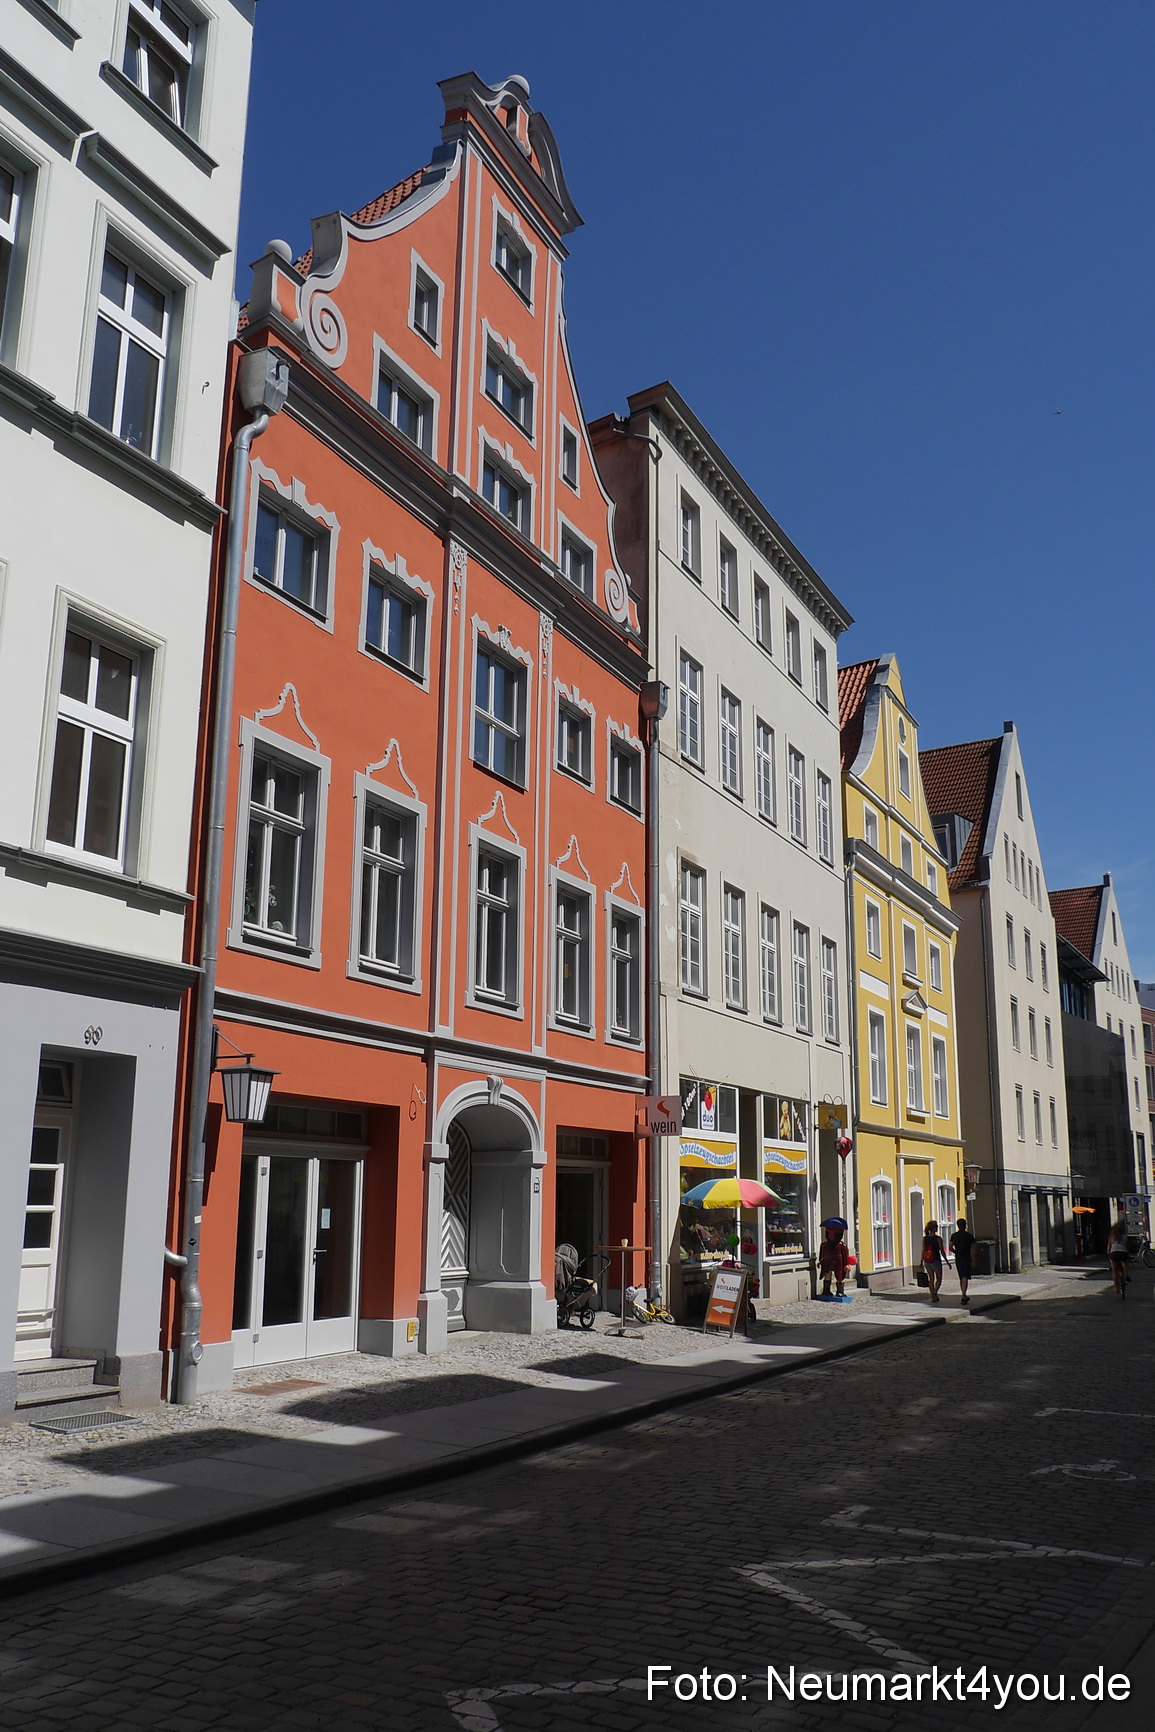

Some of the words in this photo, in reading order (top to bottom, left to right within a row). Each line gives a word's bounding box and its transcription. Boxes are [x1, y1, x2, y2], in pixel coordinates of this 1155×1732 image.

[84, 1024, 103, 1046] 90
[703, 1110, 713, 1123] duo
[651, 1121, 677, 1133] wein
